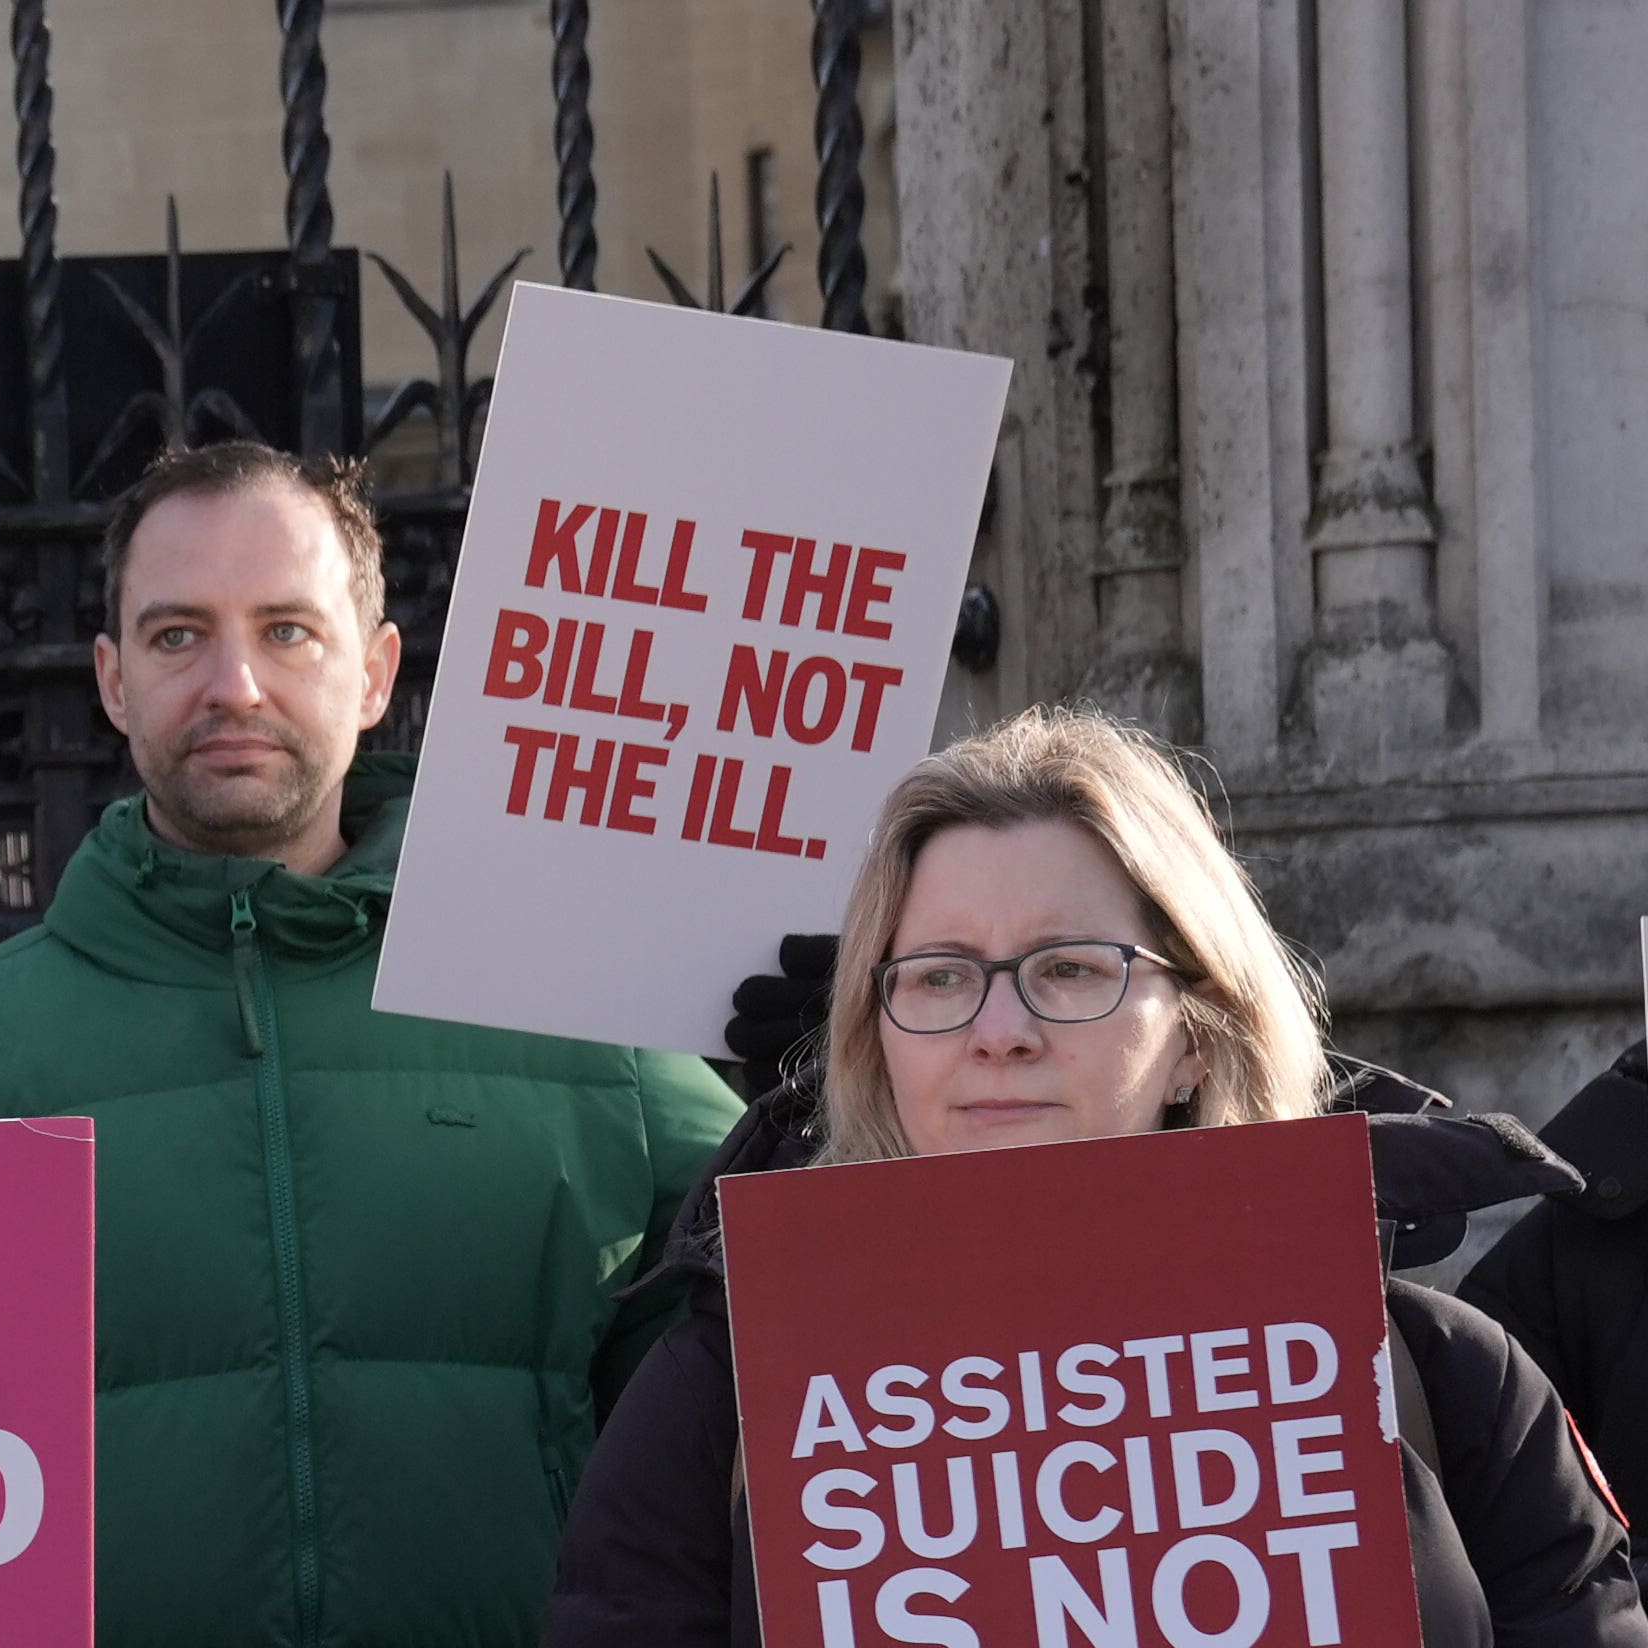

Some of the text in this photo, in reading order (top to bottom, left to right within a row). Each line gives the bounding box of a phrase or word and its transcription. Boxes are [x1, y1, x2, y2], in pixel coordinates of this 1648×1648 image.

[527, 499, 904, 639] KILL THE
[486, 610, 903, 751] BILL, NOT
[507, 726, 824, 857] THE ILL.
[792, 1323, 1337, 1458] ASSISTED
[800, 1414, 1355, 1569] SUICIDE
